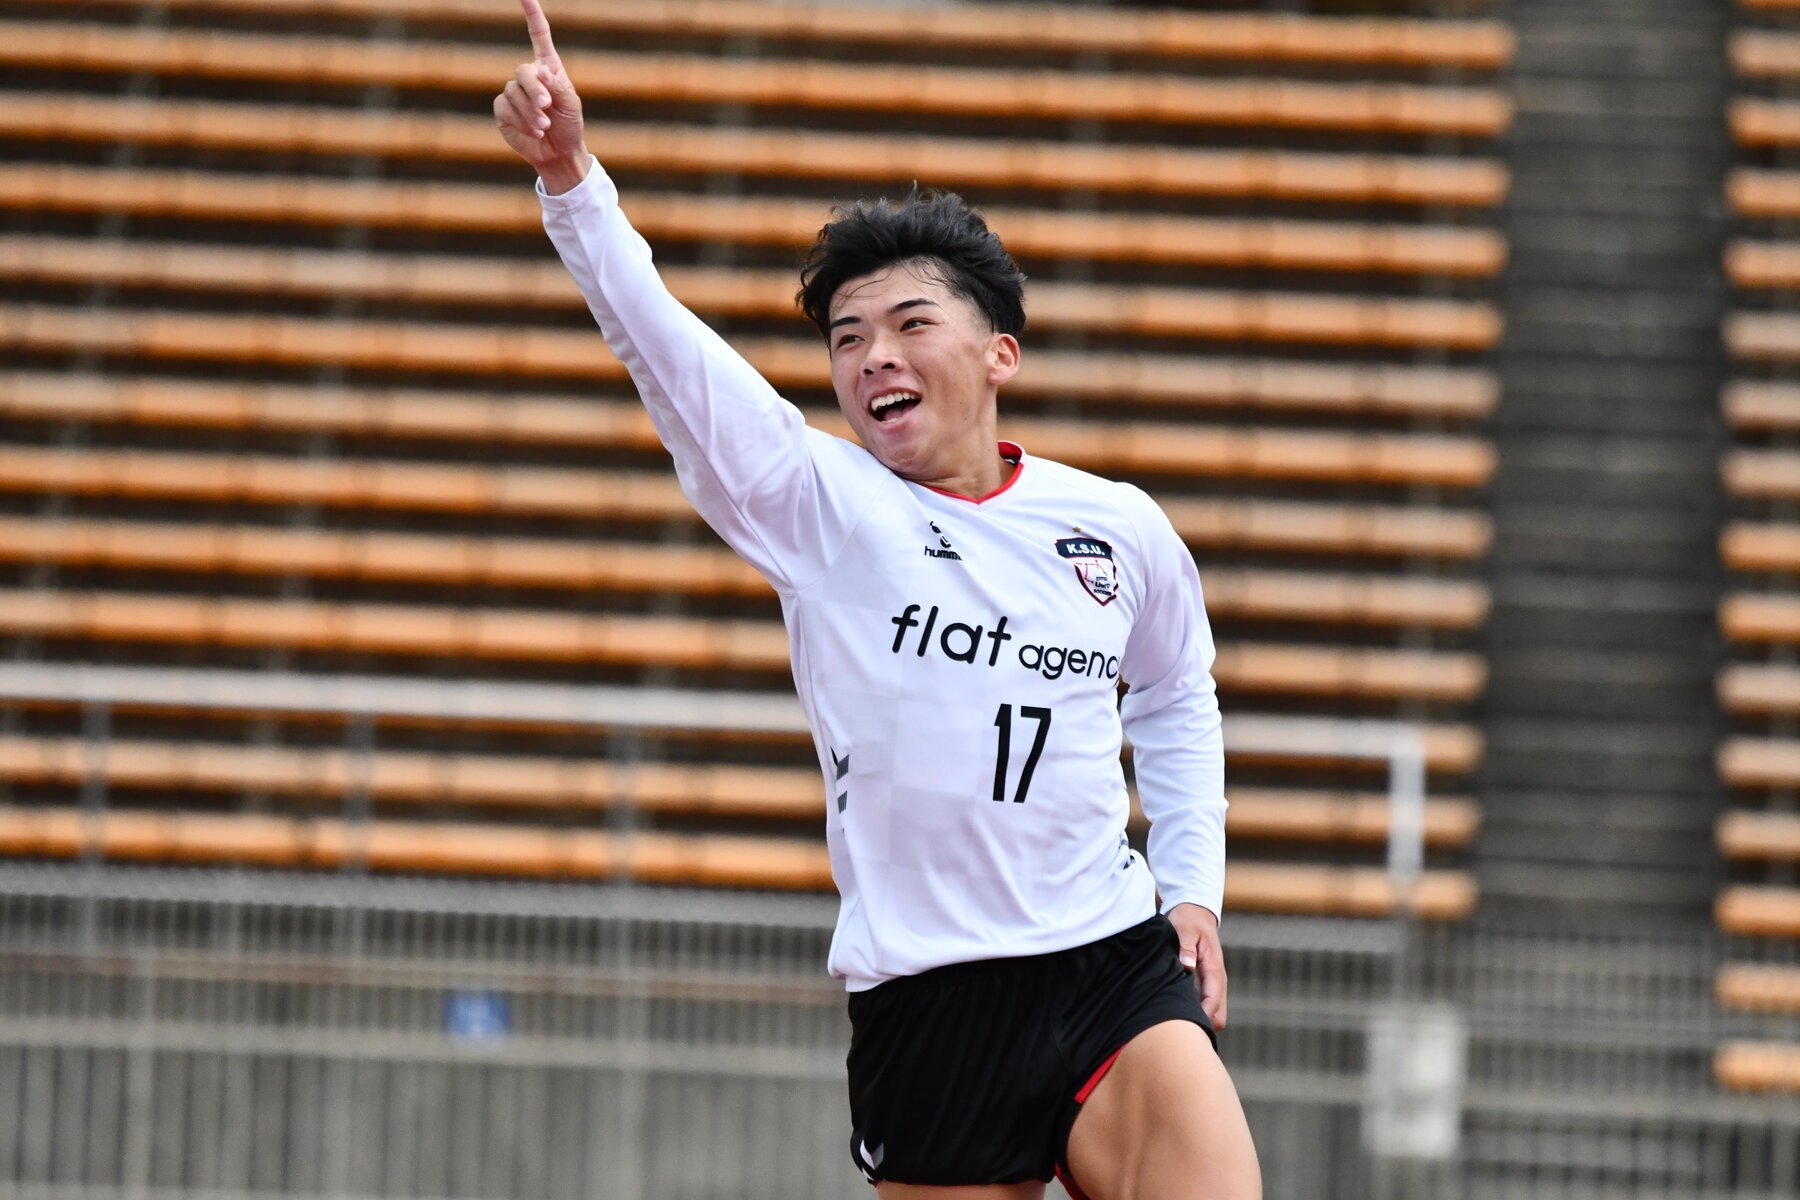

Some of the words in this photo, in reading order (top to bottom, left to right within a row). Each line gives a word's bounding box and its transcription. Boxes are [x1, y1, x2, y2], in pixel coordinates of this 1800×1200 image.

[924, 545, 962, 561] humm
[1066, 543, 1106, 556] K.S.U.
[891, 604, 1012, 667] flat
[1018, 644, 1119, 680] agenc
[992, 703, 1051, 803] 17
